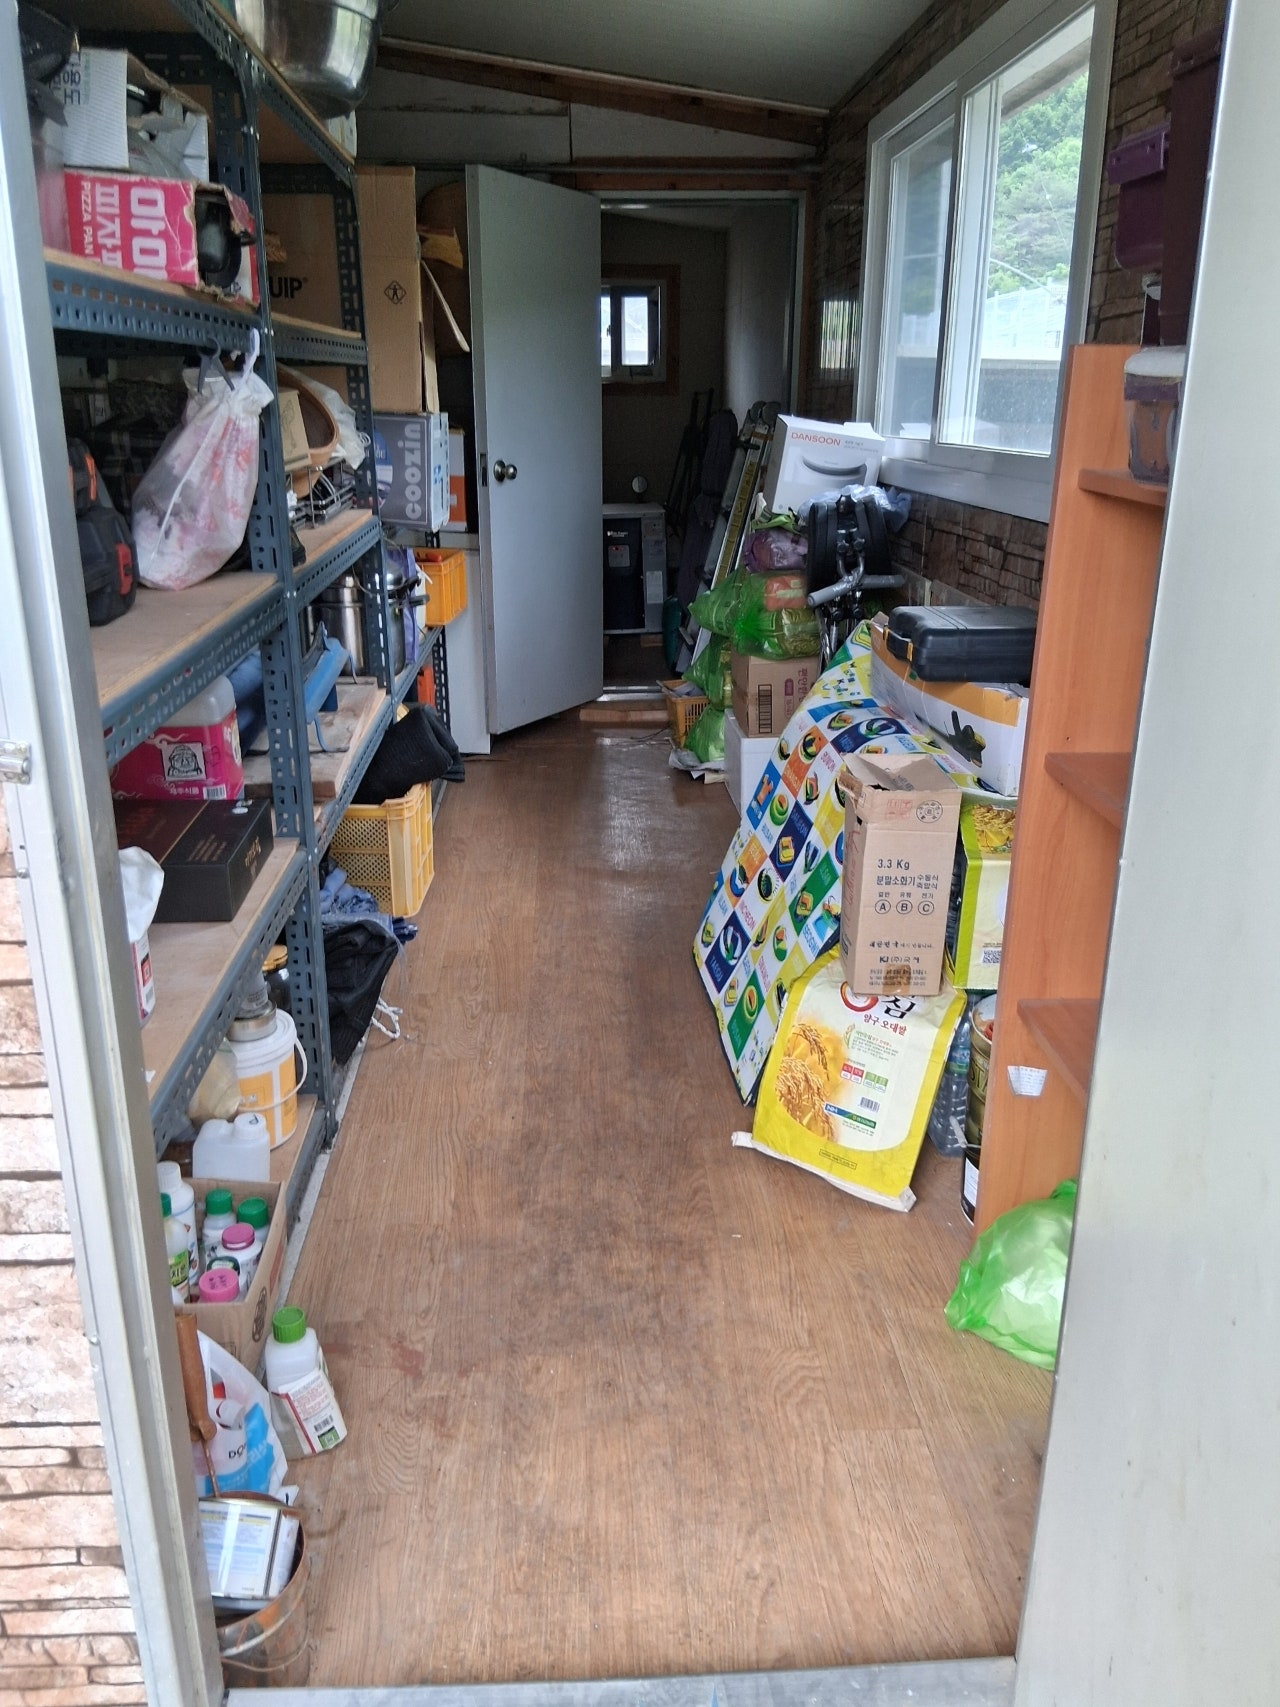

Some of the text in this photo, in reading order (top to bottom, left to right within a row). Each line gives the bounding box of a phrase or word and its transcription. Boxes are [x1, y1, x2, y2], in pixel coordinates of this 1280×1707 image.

[81, 181, 94, 255] PIZZA PAN
[791, 431, 841, 446] DANSOON
[397, 423, 422, 520] coozin
[877, 859, 910, 871] 3.3 Kg
[876, 875, 916, 886] 분말소화기
